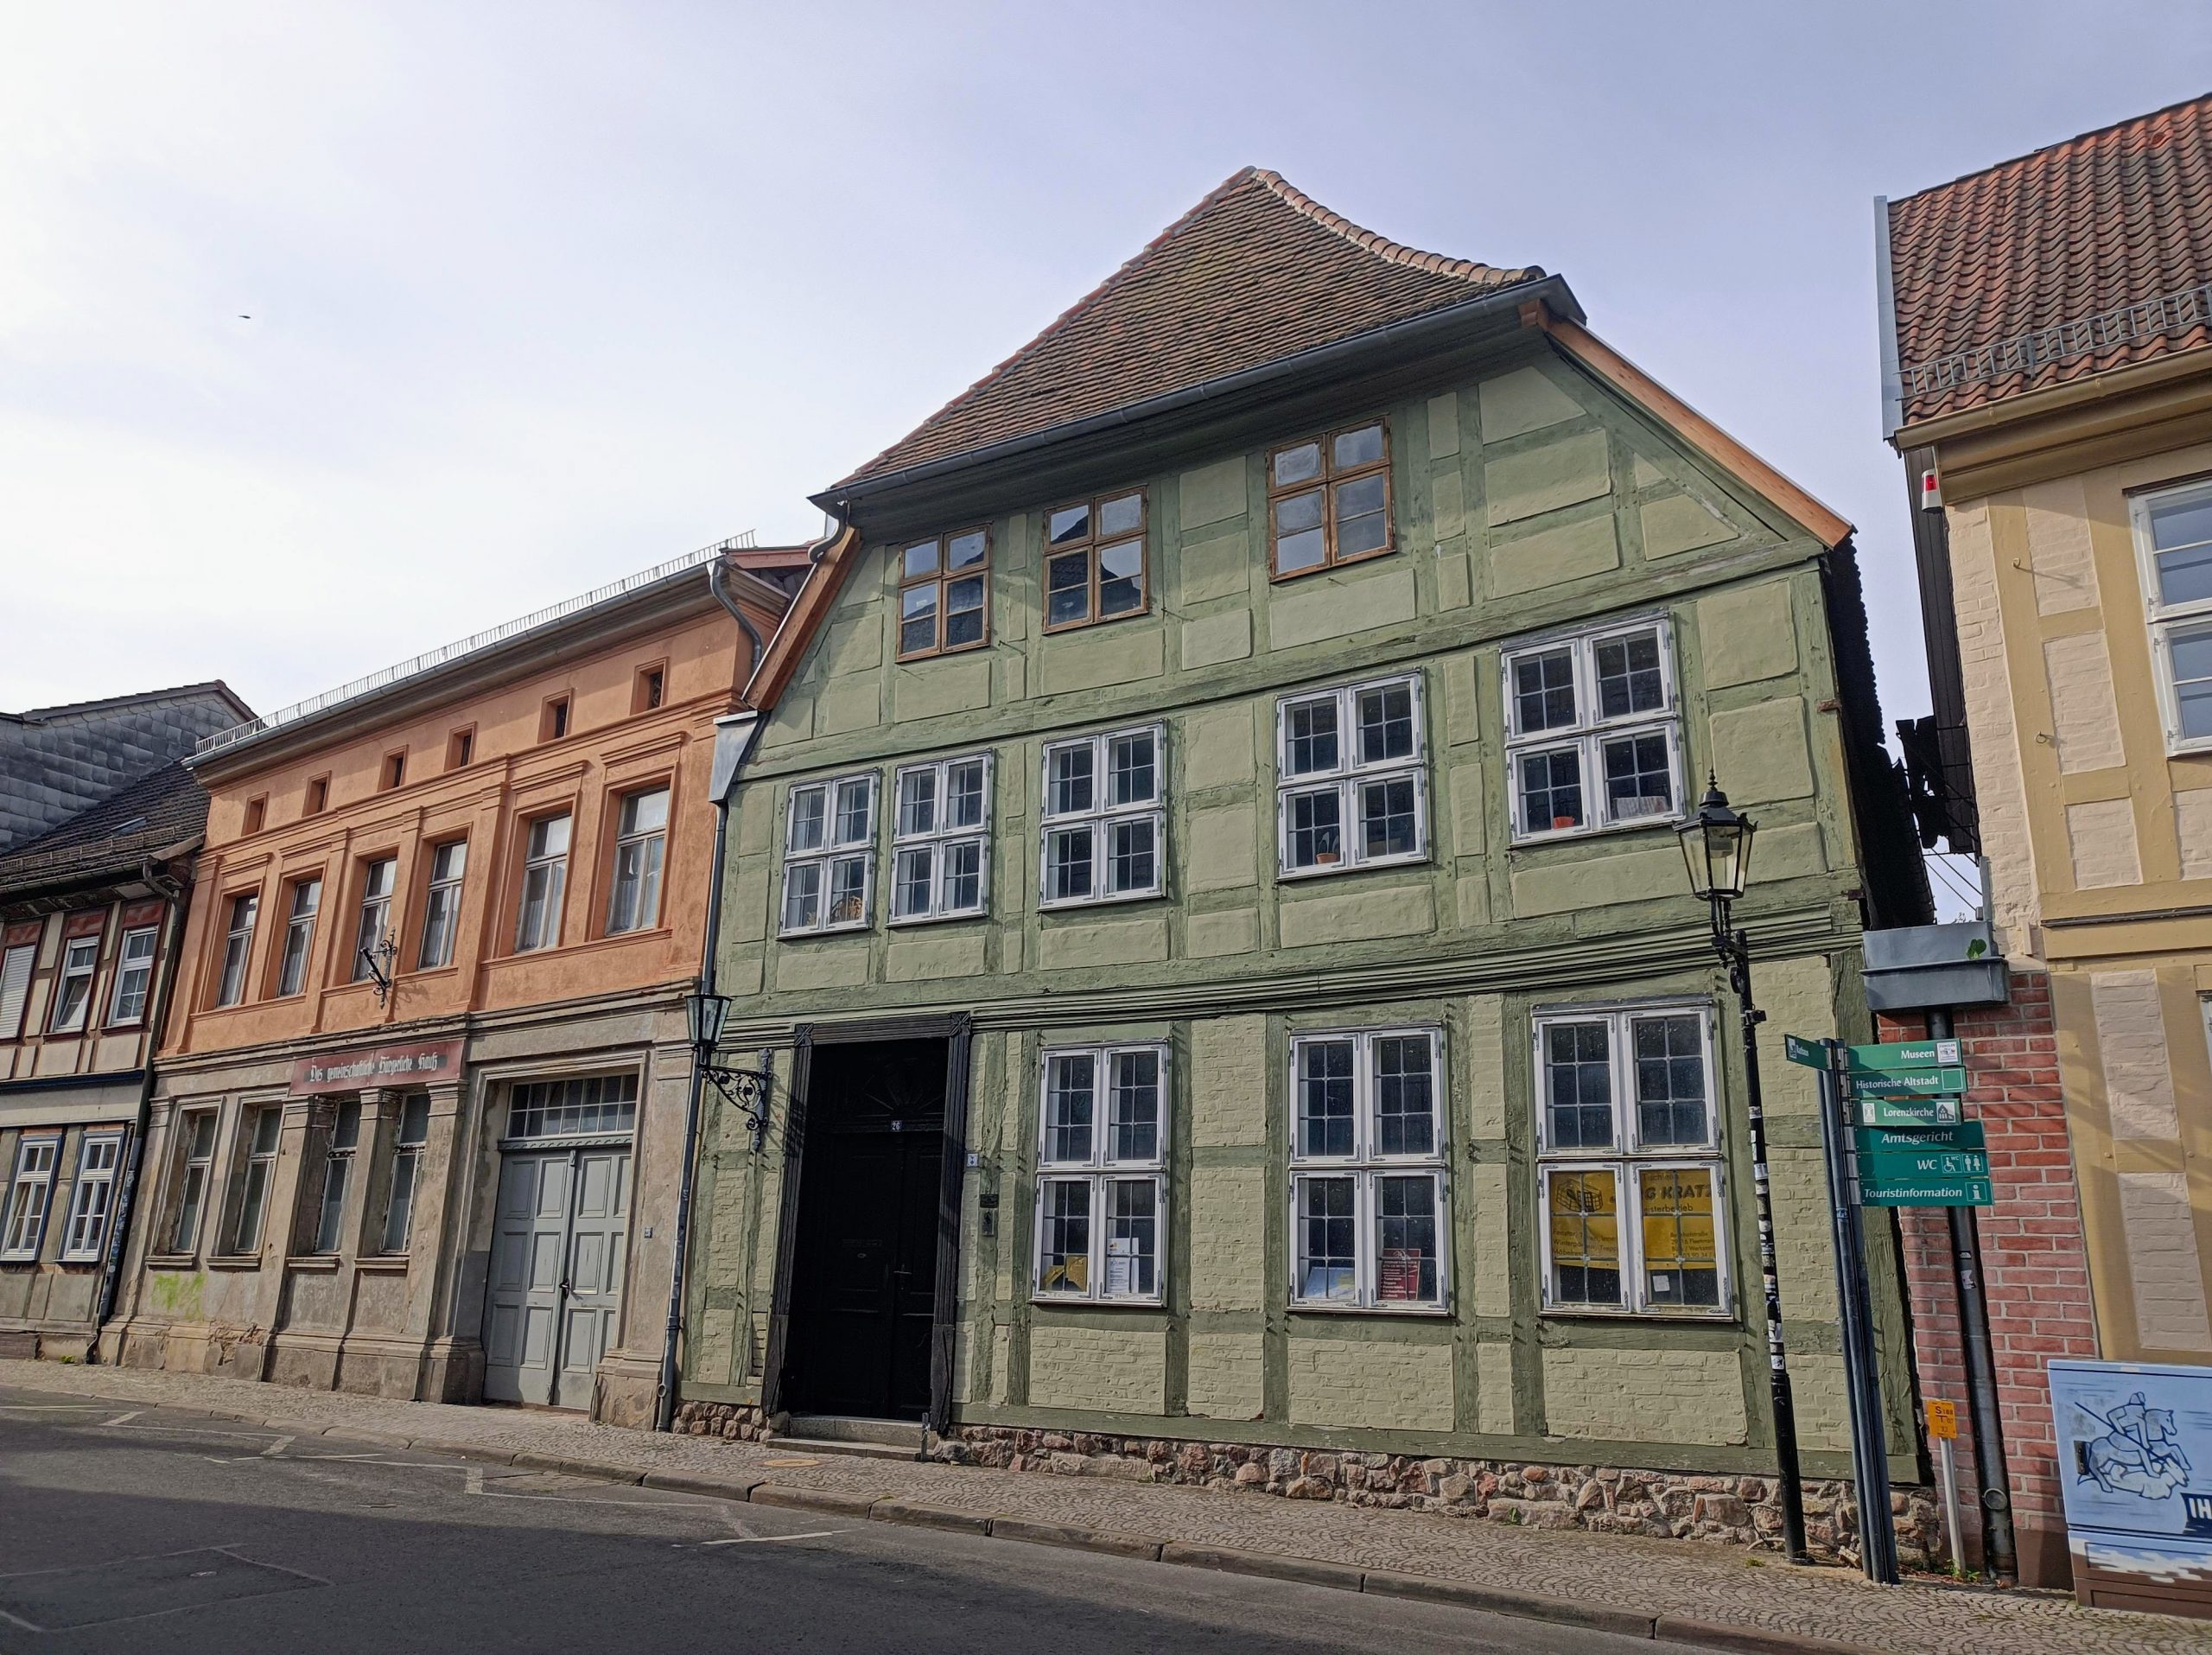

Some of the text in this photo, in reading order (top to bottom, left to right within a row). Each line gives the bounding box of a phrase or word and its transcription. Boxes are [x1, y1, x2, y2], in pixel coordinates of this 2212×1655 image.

[1900, 1049, 1936, 1060] Museen
[1856, 1075, 1939, 1089] Historische Altstadt
[1883, 1107, 1935, 1117] Lorenzkirche
[1881, 1131, 1954, 1145] Amtsgericht
[1916, 1159, 1937, 1170] WC
[1864, 1187, 1963, 1199] Touristinformation
